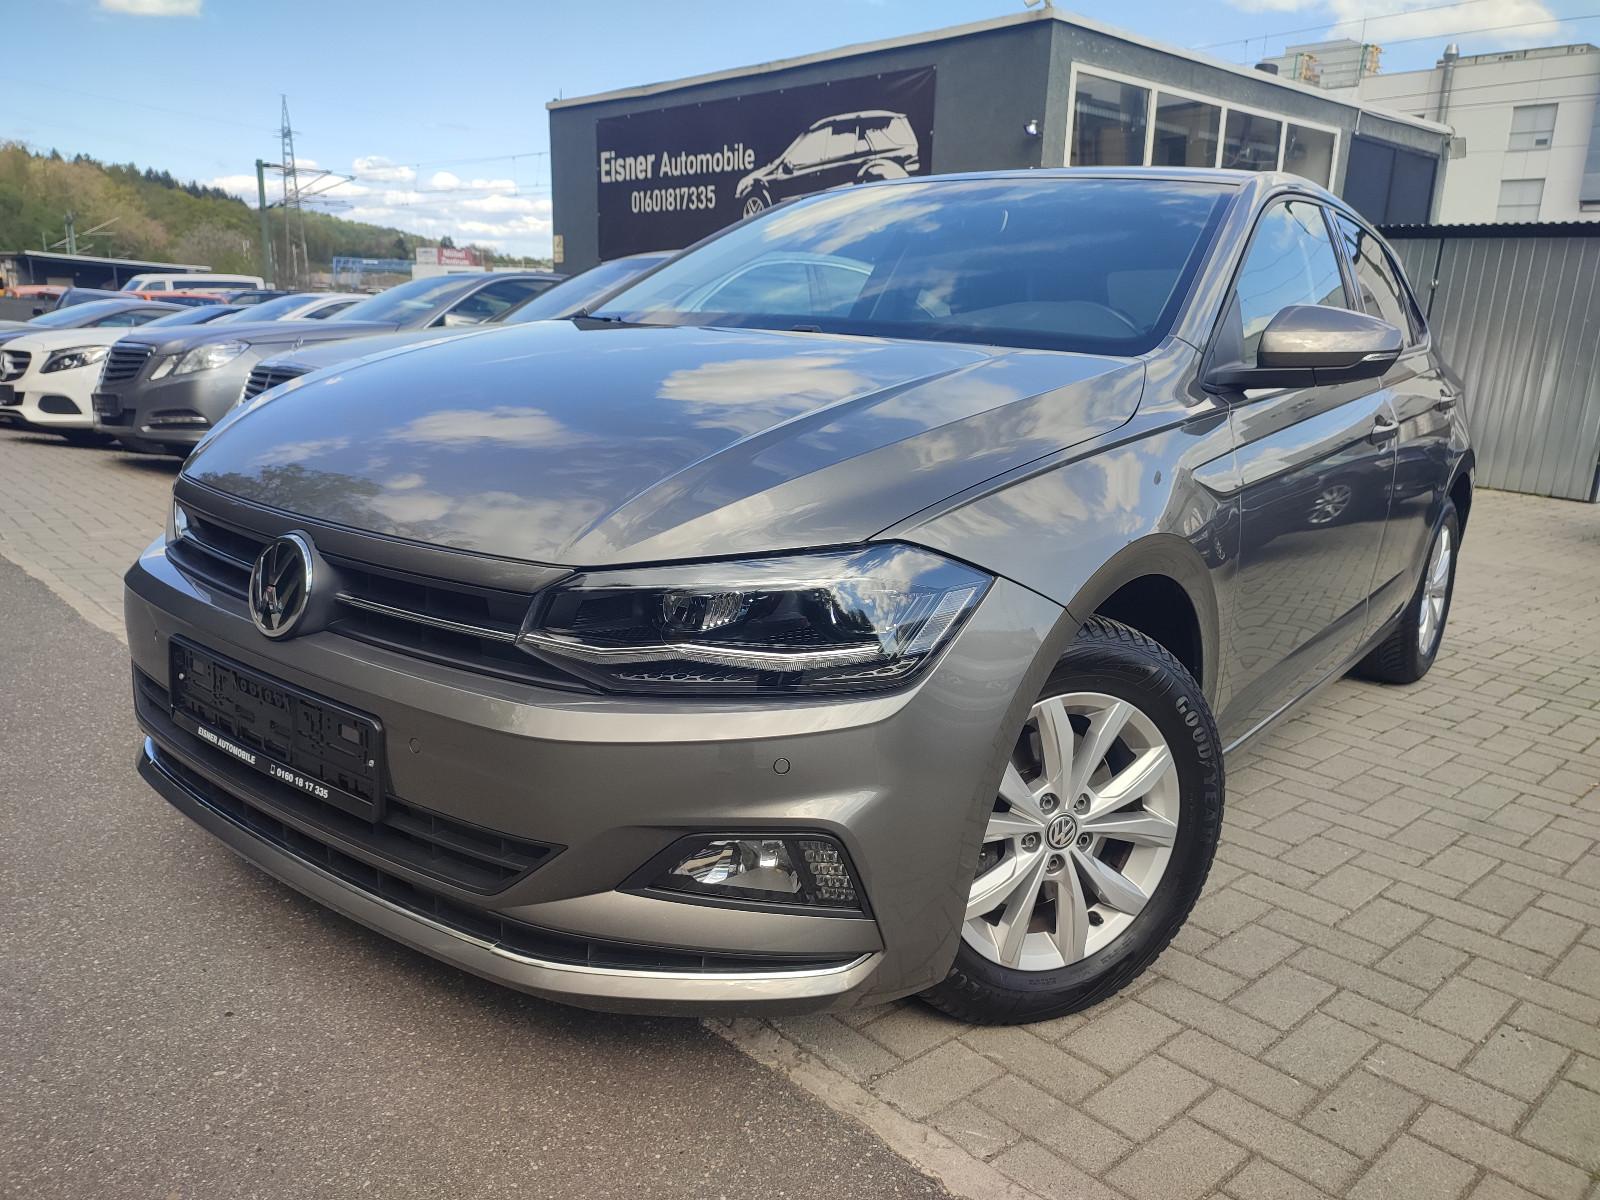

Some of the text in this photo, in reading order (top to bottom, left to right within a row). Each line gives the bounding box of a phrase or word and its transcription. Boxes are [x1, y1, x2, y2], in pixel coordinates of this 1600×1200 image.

[600, 143, 755, 183] Eisner Automobile
[631, 185, 716, 213] 01601817335
[197, 726, 256, 765] EISNER AUTOMOBILE
[276, 768, 329, 799] 0160 18 17 335
